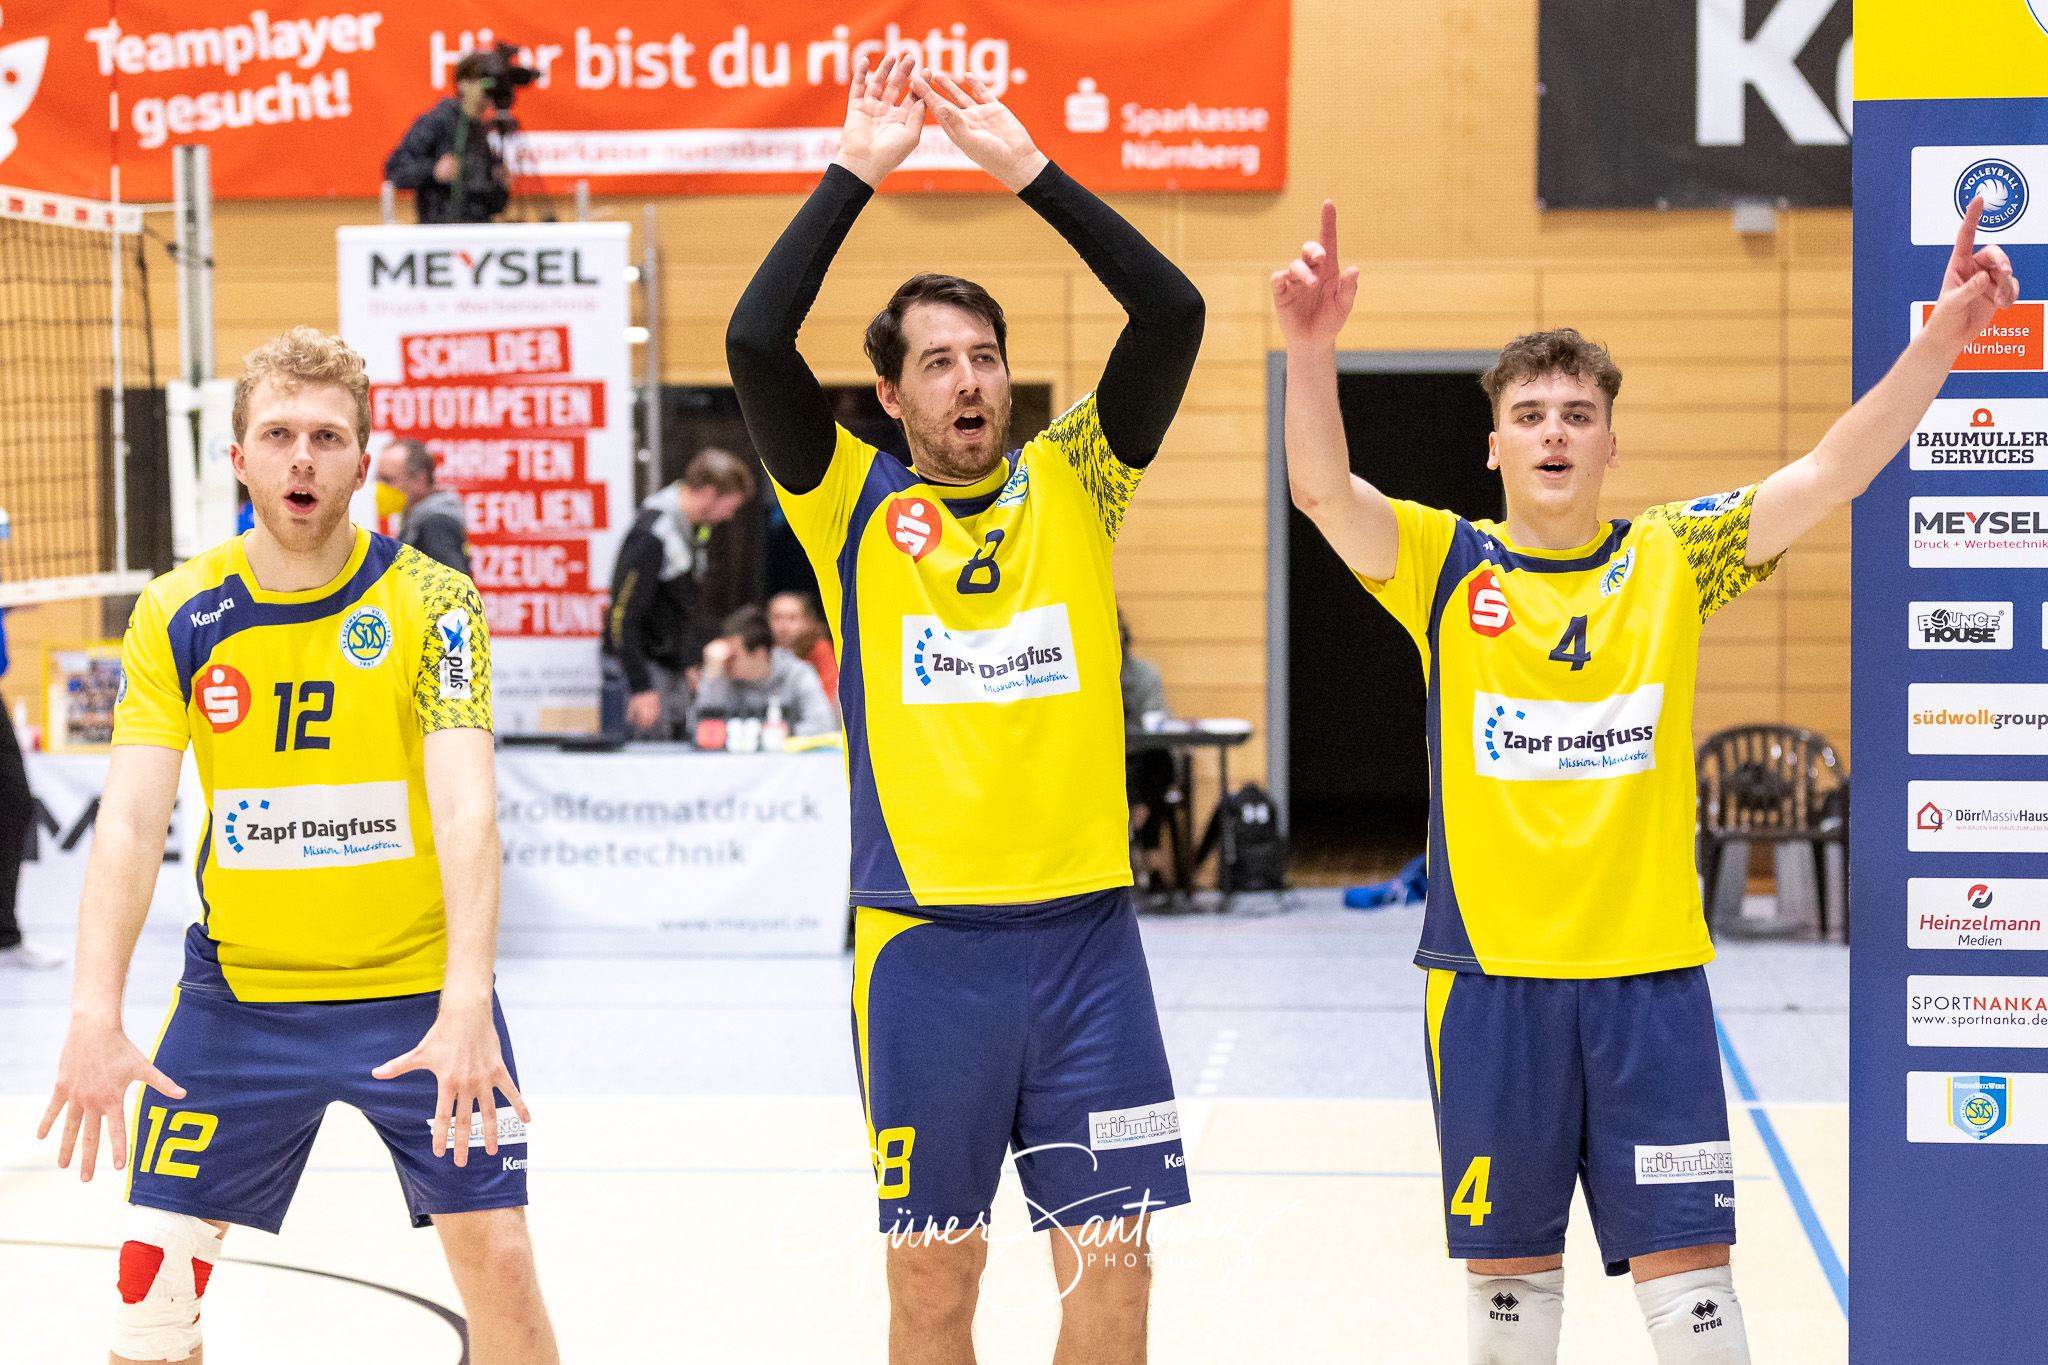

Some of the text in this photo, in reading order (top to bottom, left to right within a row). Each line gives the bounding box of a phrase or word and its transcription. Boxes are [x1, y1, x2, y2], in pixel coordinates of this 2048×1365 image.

[85, 10, 383, 76] Teamplayer
[574, 26, 697, 89] bist
[709, 24, 790, 88] du
[131, 68, 352, 149] gesucht!
[1120, 102, 1269, 138] Sparkasse
[1121, 139, 1260, 176] Nürnberg
[1964, 167, 2018, 190] VOLLEYBALL
[1966, 203, 2018, 224] DESLIGA
[369, 249, 599, 288] MEYSEL
[1979, 325, 2030, 337] arkasse
[406, 329, 562, 379] SCHILDER
[1963, 342, 2026, 357] Nürnberg
[373, 385, 593, 430] FOTOTAPETEN
[1931, 449, 2034, 464] SERVICES
[1914, 511, 2048, 534] MEYSEL
[1914, 540, 1949, 549] Druck
[1964, 540, 2048, 549] Werbetechnik
[1548, 614, 1591, 671] 4
[1925, 628, 1995, 643] HOUSE
[445, 656, 468, 689] puls
[932, 646, 1062, 679] Zapf Daigfuss
[273, 680, 335, 752] 12
[1503, 726, 1653, 754] Zapf Daigfuss
[1955, 809, 2048, 822] DörrMassivHaus
[246, 818, 396, 844] Zapf Daigfuss
[1919, 915, 2041, 931] Heinzelmann
[1958, 935, 2002, 946] Medien
[1912, 996, 2048, 1011] SPORTNANKA
[1912, 1013, 2048, 1028] www.sportnanka.de
[139, 1105, 219, 1179] 12
[877, 1126, 916, 1199] 8
[1450, 1156, 1492, 1226] 4
